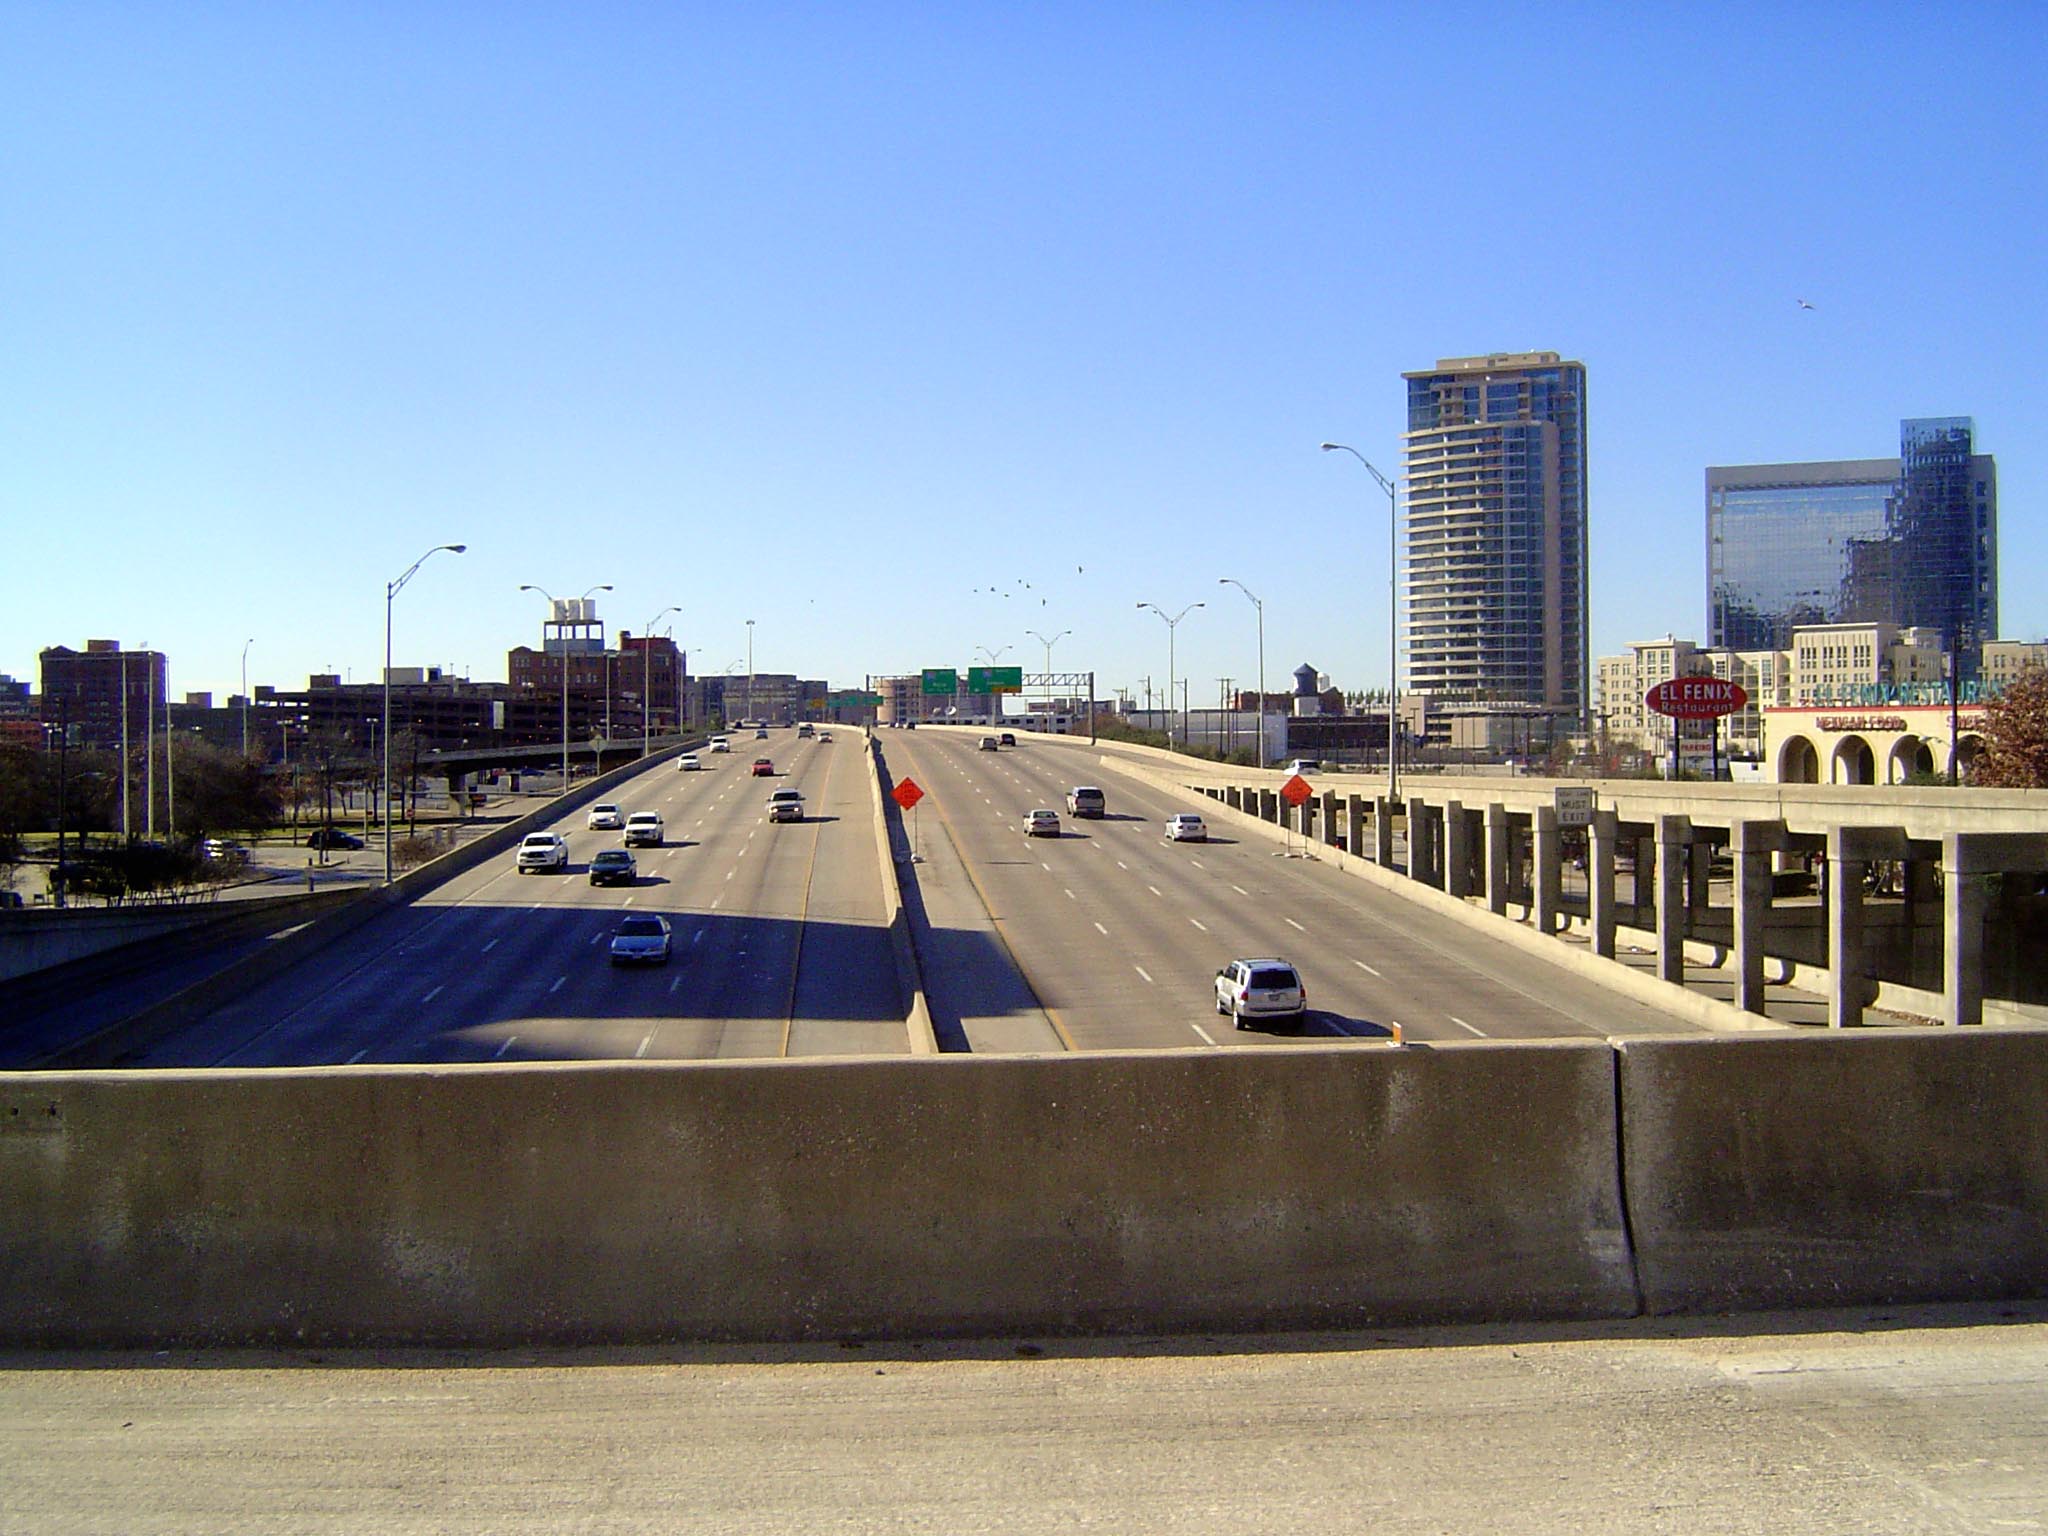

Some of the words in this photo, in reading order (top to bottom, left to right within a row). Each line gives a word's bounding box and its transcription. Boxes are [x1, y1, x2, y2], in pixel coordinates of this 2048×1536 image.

[1660, 684, 1678, 700] EL
[1683, 684, 1733, 700] FENIX
[1816, 683, 1836, 707] EL
[1841, 682, 1890, 707] FENIX
[1901, 679, 2013, 705] RESTAURAN
[1661, 702, 1733, 713] Restaurant
[1946, 715, 1982, 727] SNCE
[1561, 800, 1586, 809] MUST
[1562, 812, 1585, 821] EXIT
